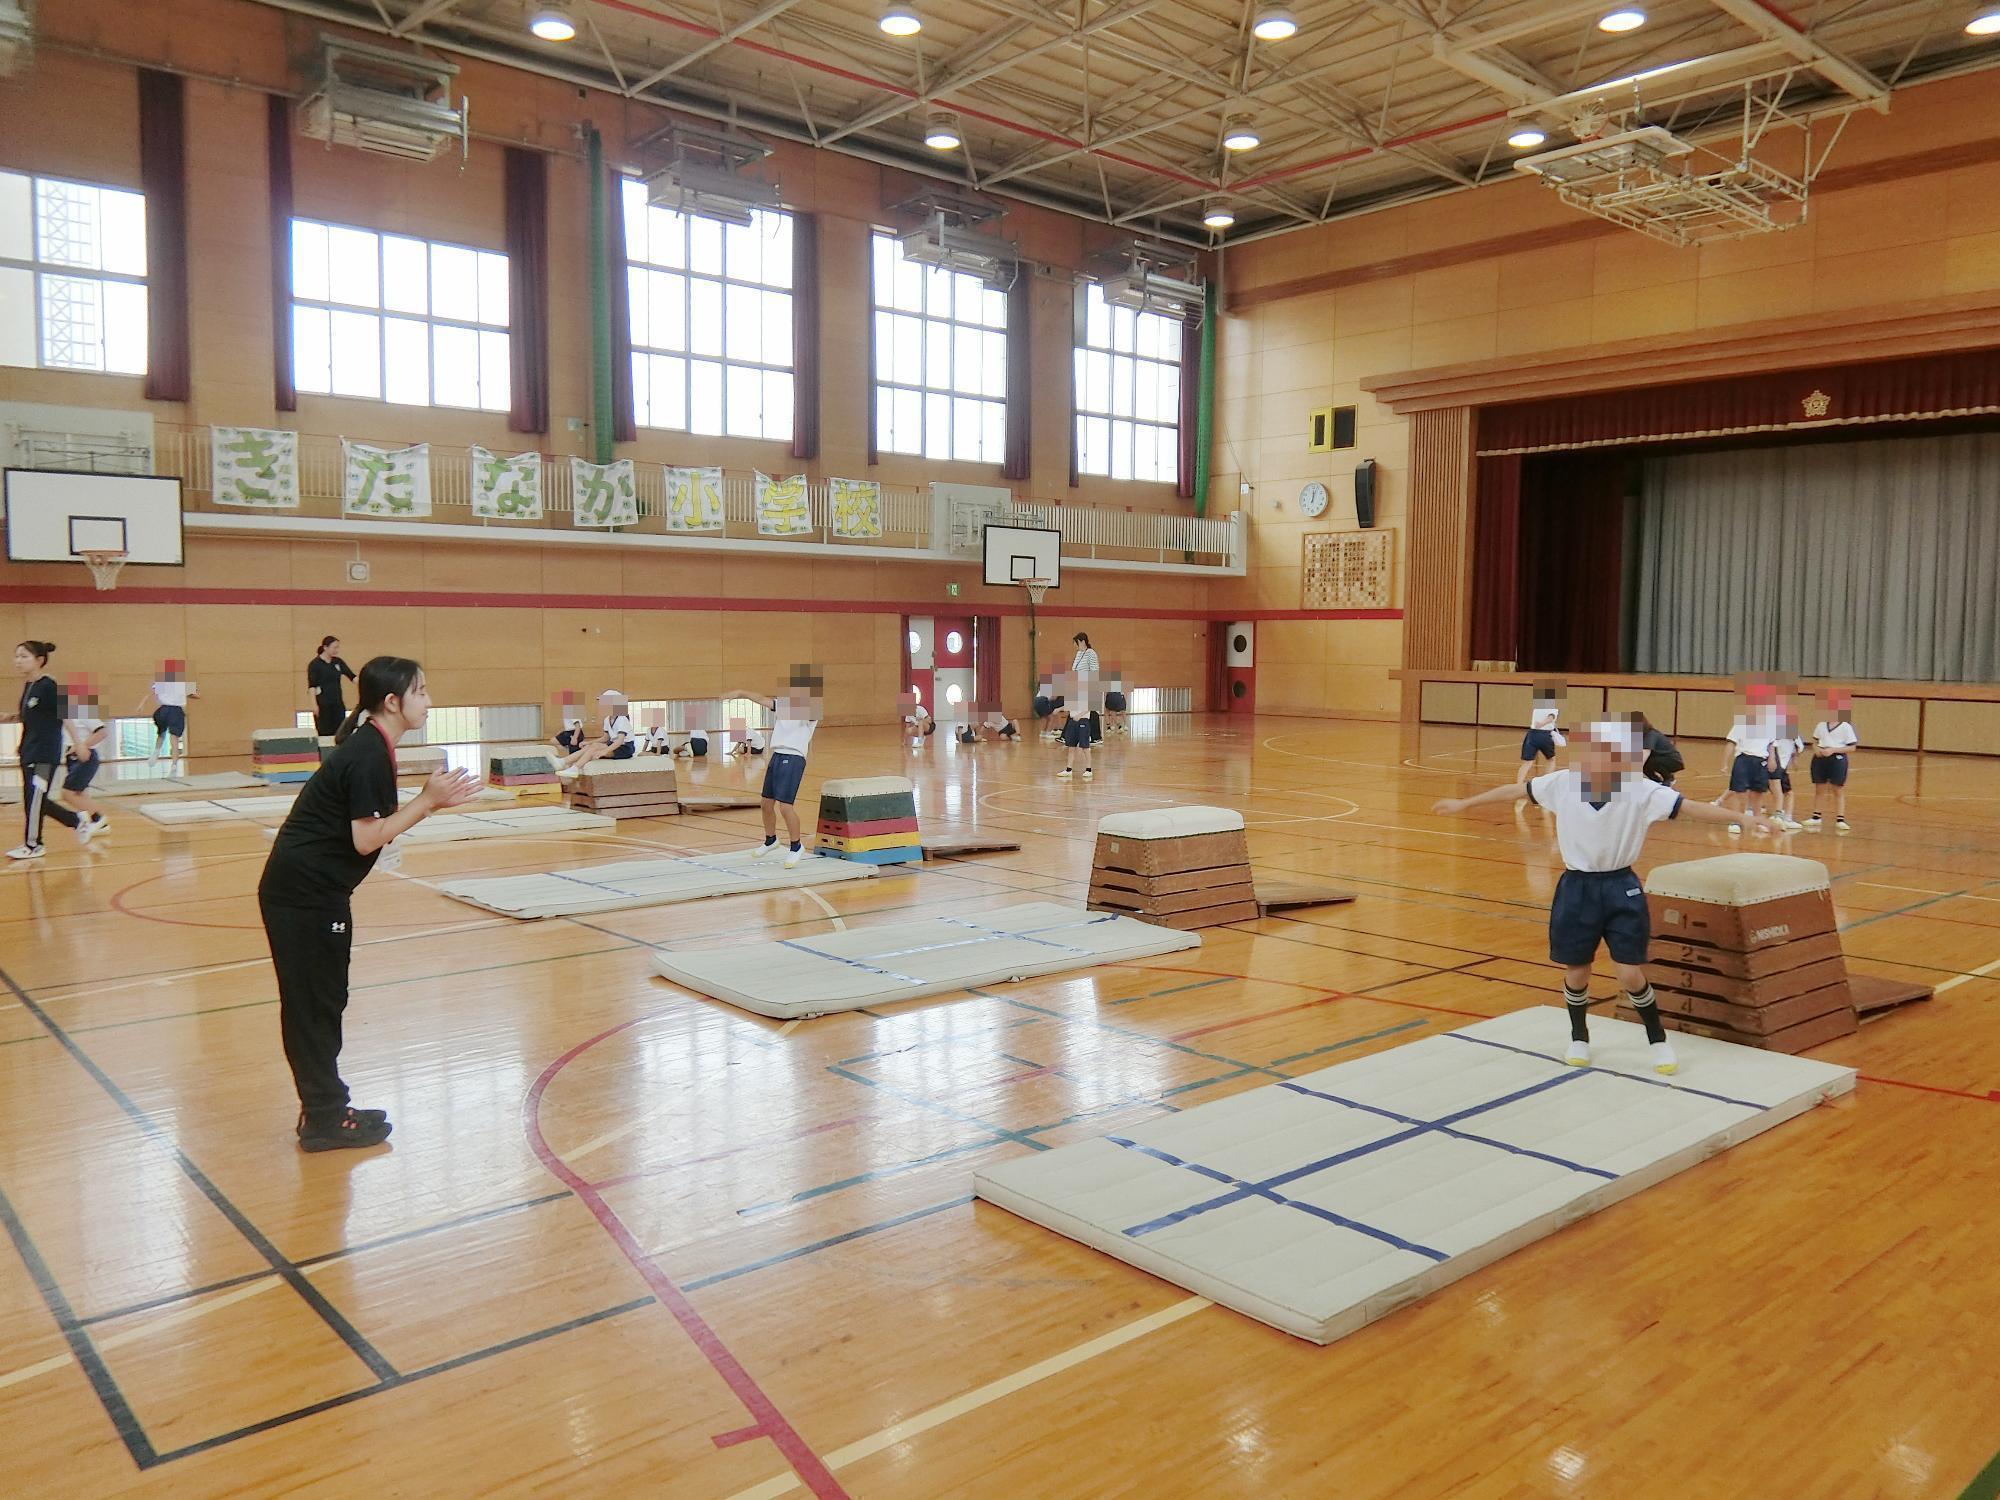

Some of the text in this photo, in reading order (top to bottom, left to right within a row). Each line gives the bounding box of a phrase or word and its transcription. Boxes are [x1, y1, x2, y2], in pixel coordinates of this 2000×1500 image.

[224, 432, 880, 535] き た な か 小 学 校
[1682, 914, 1689, 929] 1
[1681, 946, 1693, 962] 2
[1681, 972, 1692, 988] 3
[1681, 998, 1692, 1013] 4
